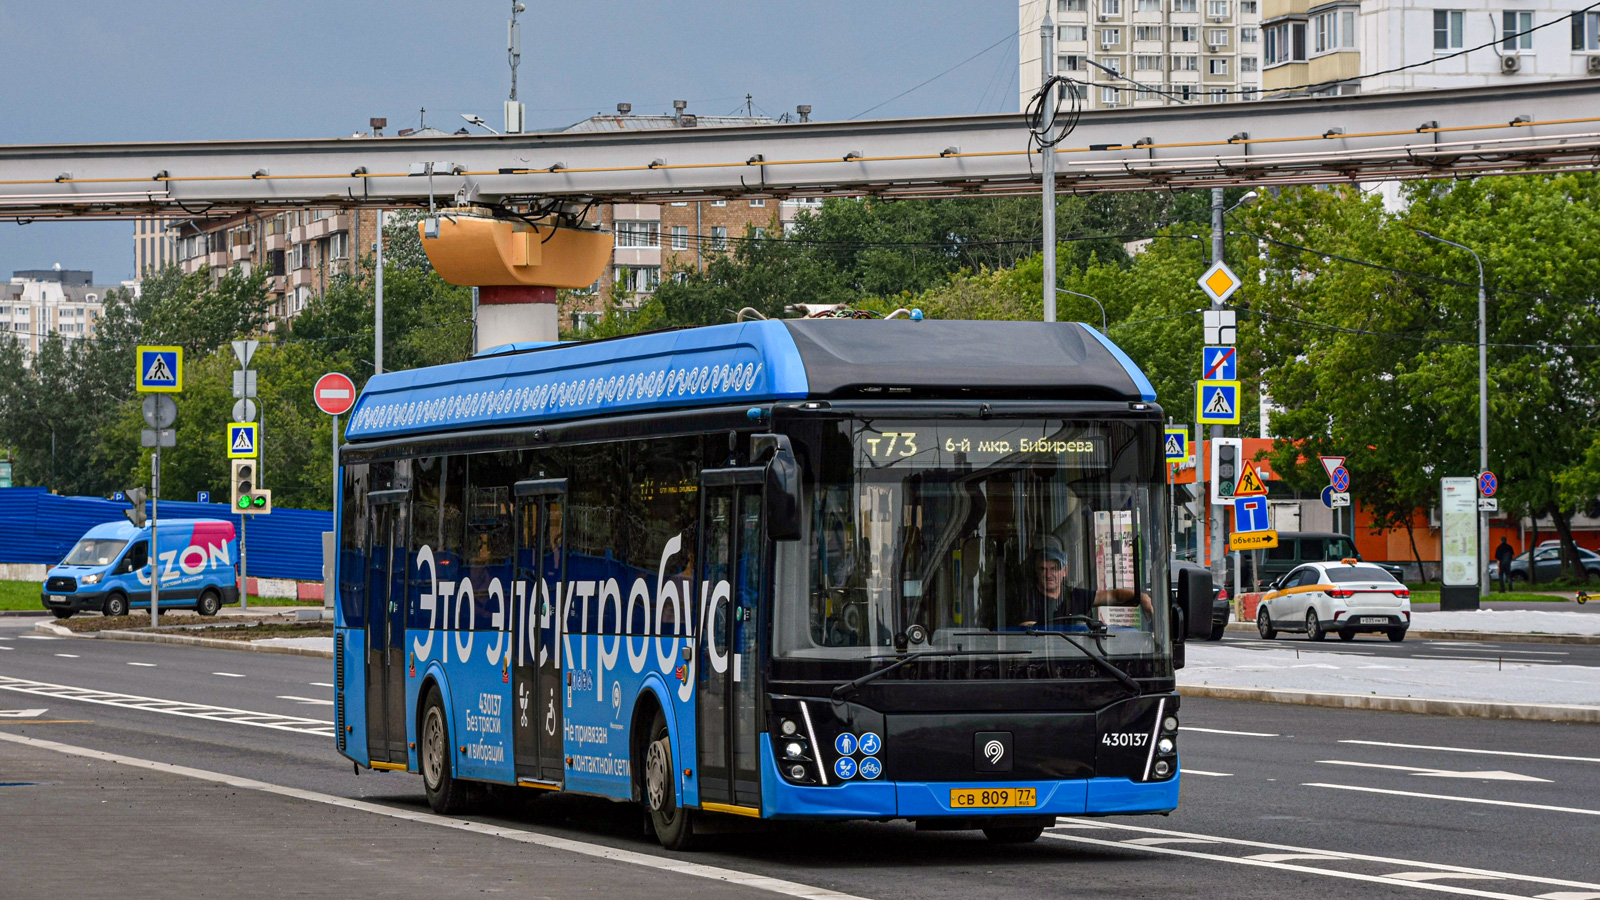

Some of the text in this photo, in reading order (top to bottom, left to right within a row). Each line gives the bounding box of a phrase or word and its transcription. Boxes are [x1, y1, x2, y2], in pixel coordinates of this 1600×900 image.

[866, 432, 918, 457] т73
[945, 437, 1094, 455] 6-й мкр. Бибирева
[1233, 536, 1261, 545] объезд
[413, 544, 475, 664] Это
[479, 692, 502, 716] 430137
[466, 709, 501, 737] Без тряски
[564, 718, 574, 741] Не
[575, 725, 608, 748] привязан
[1102, 733, 1149, 747] 430137
[467, 738, 504, 766] и вибраций
[573, 753, 613, 775] контактной
[614, 758, 631, 776] сети
[958, 790, 1009, 805] СВ 809
[1017, 789, 1031, 800] 77
